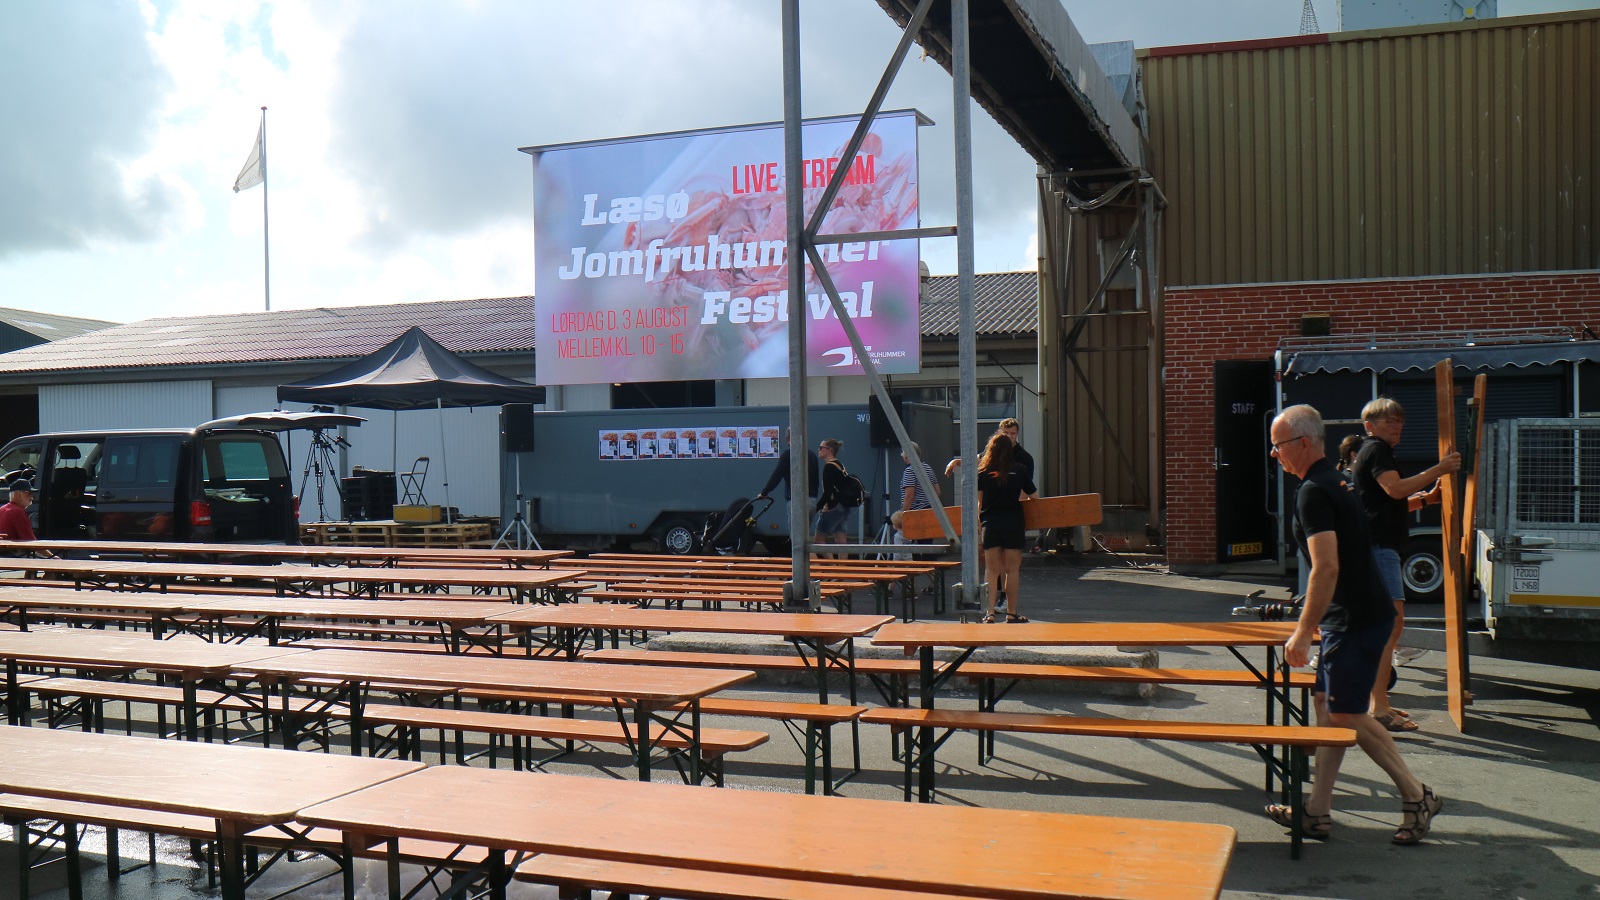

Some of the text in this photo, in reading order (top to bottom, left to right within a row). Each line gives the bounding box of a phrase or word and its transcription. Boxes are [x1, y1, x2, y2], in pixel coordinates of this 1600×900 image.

[732, 154, 875, 195] LIVE TREAM
[581, 189, 690, 226] Læsø
[700, 281, 874, 325] Festval
[552, 305, 690, 333] LØRDAG D. 3 AUGUST
[557, 337, 613, 359] MELLEM
[615, 336, 636, 357] KL.
[640, 334, 655, 356] 10
[669, 333, 685, 355] 15
[1232, 403, 1255, 414] STAFF
[1234, 545, 1243, 554] FE
[1244, 544, 1252, 553] 35
